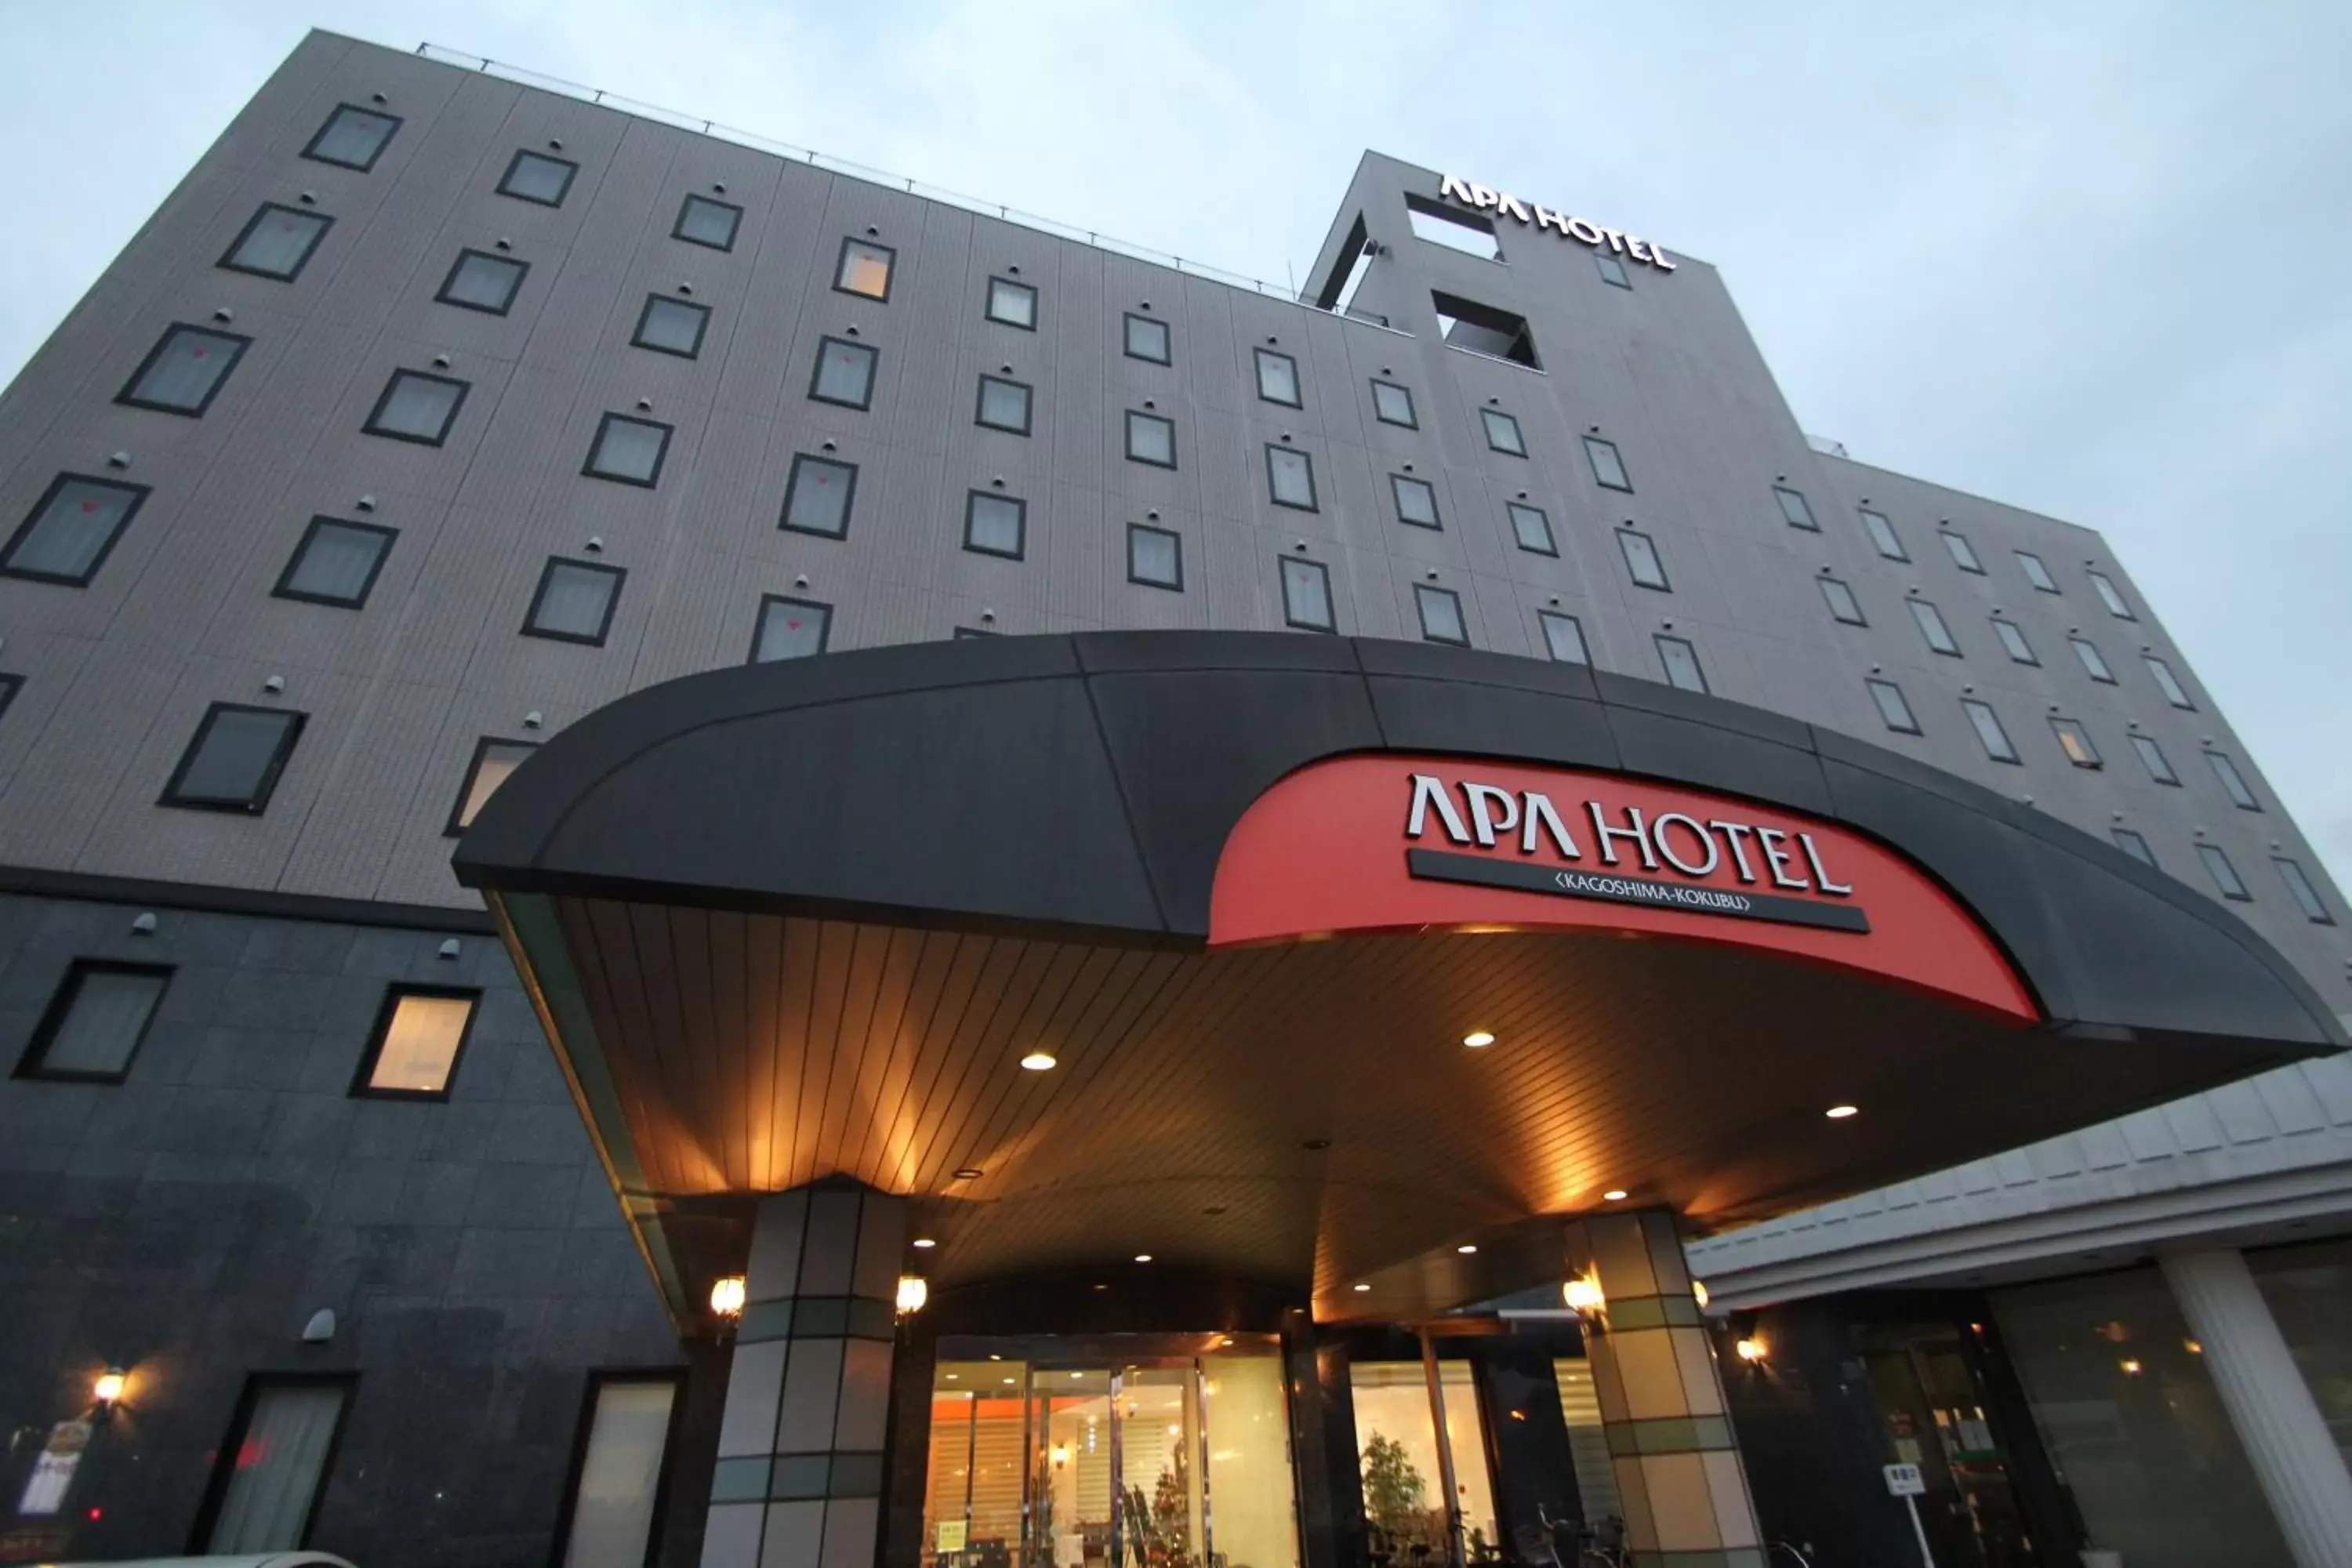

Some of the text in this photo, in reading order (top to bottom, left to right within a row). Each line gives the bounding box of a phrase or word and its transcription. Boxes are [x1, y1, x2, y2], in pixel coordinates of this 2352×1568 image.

[1439, 174, 1677, 271] APA HOTEL
[1407, 773, 1853, 895] APA HOTEL
